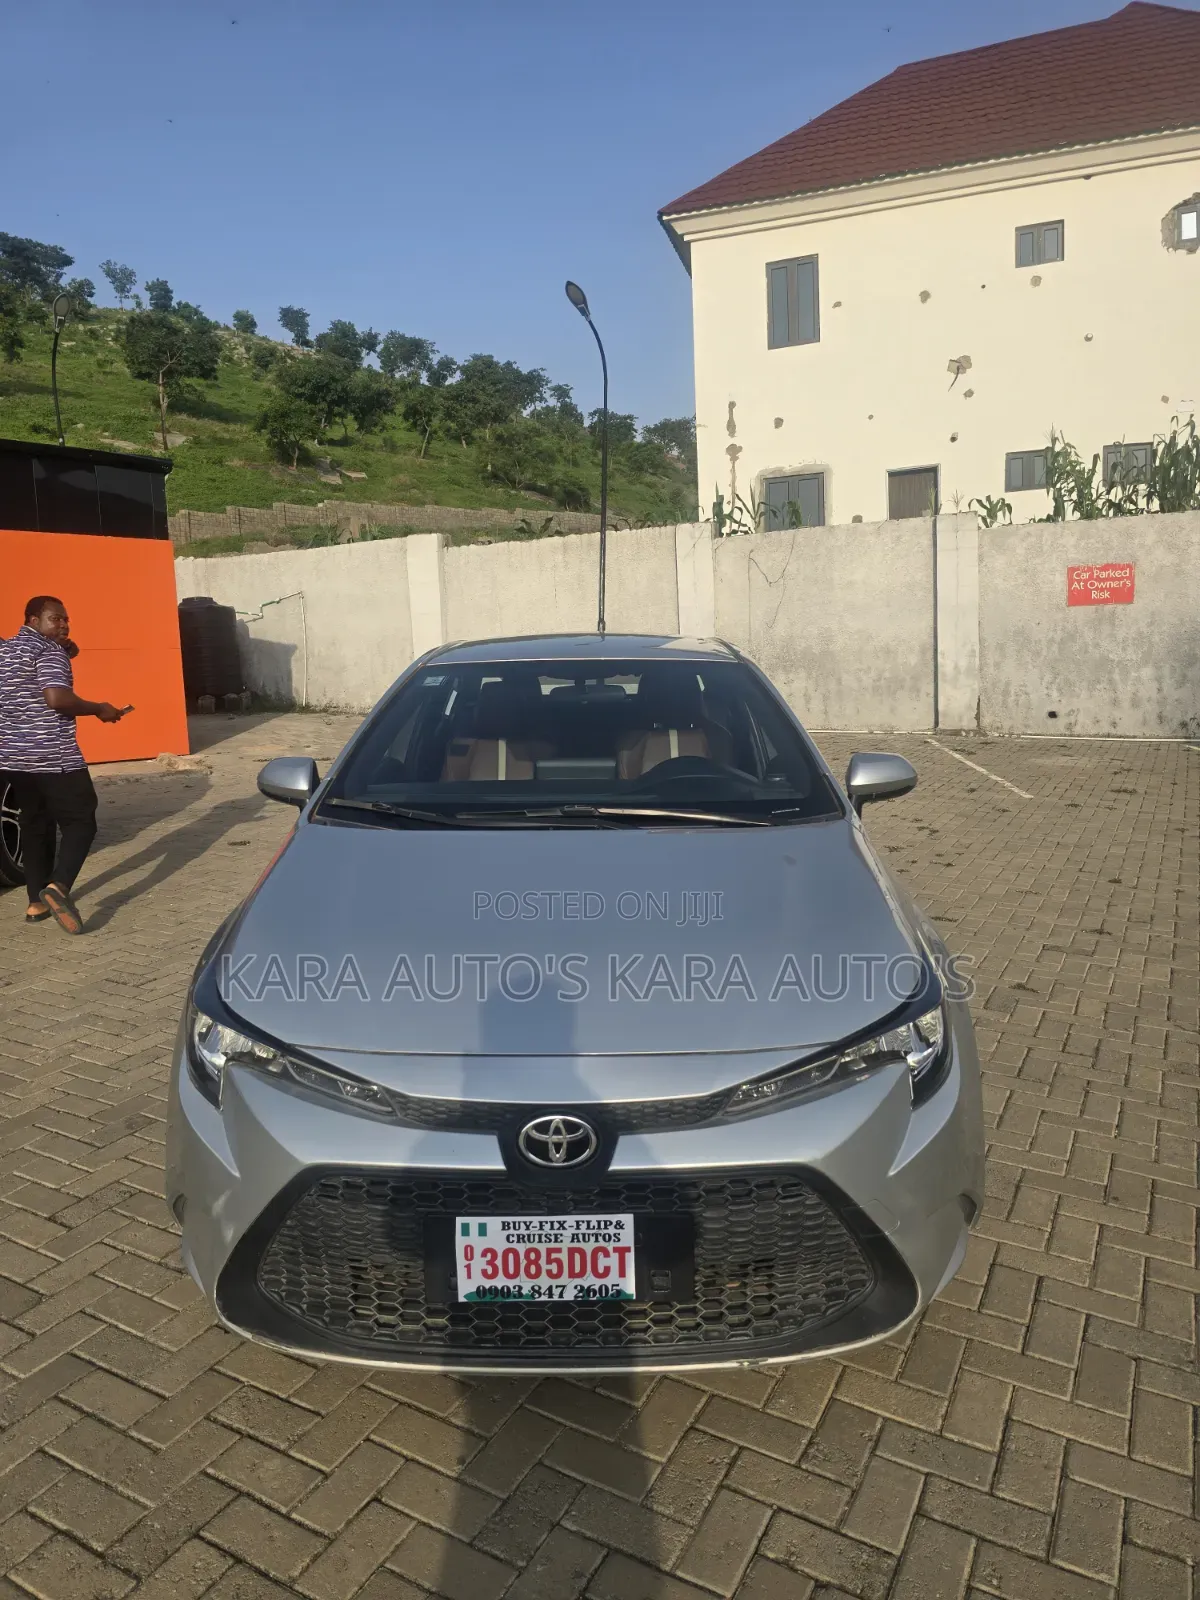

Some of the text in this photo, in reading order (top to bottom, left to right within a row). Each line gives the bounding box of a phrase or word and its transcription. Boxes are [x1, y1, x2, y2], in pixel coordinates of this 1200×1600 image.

[1073, 568, 1130, 580] Car Parked
[1071, 579, 1132, 590] At Owner's
[1091, 590, 1111, 600] Risk
[501, 1220, 626, 1231] BUY-FIX-FLIP&
[506, 1232, 621, 1244] CRUISE AUTOS
[480, 1246, 632, 1280] 3085DCT
[475, 1283, 622, 1299] 0903 847 2605
